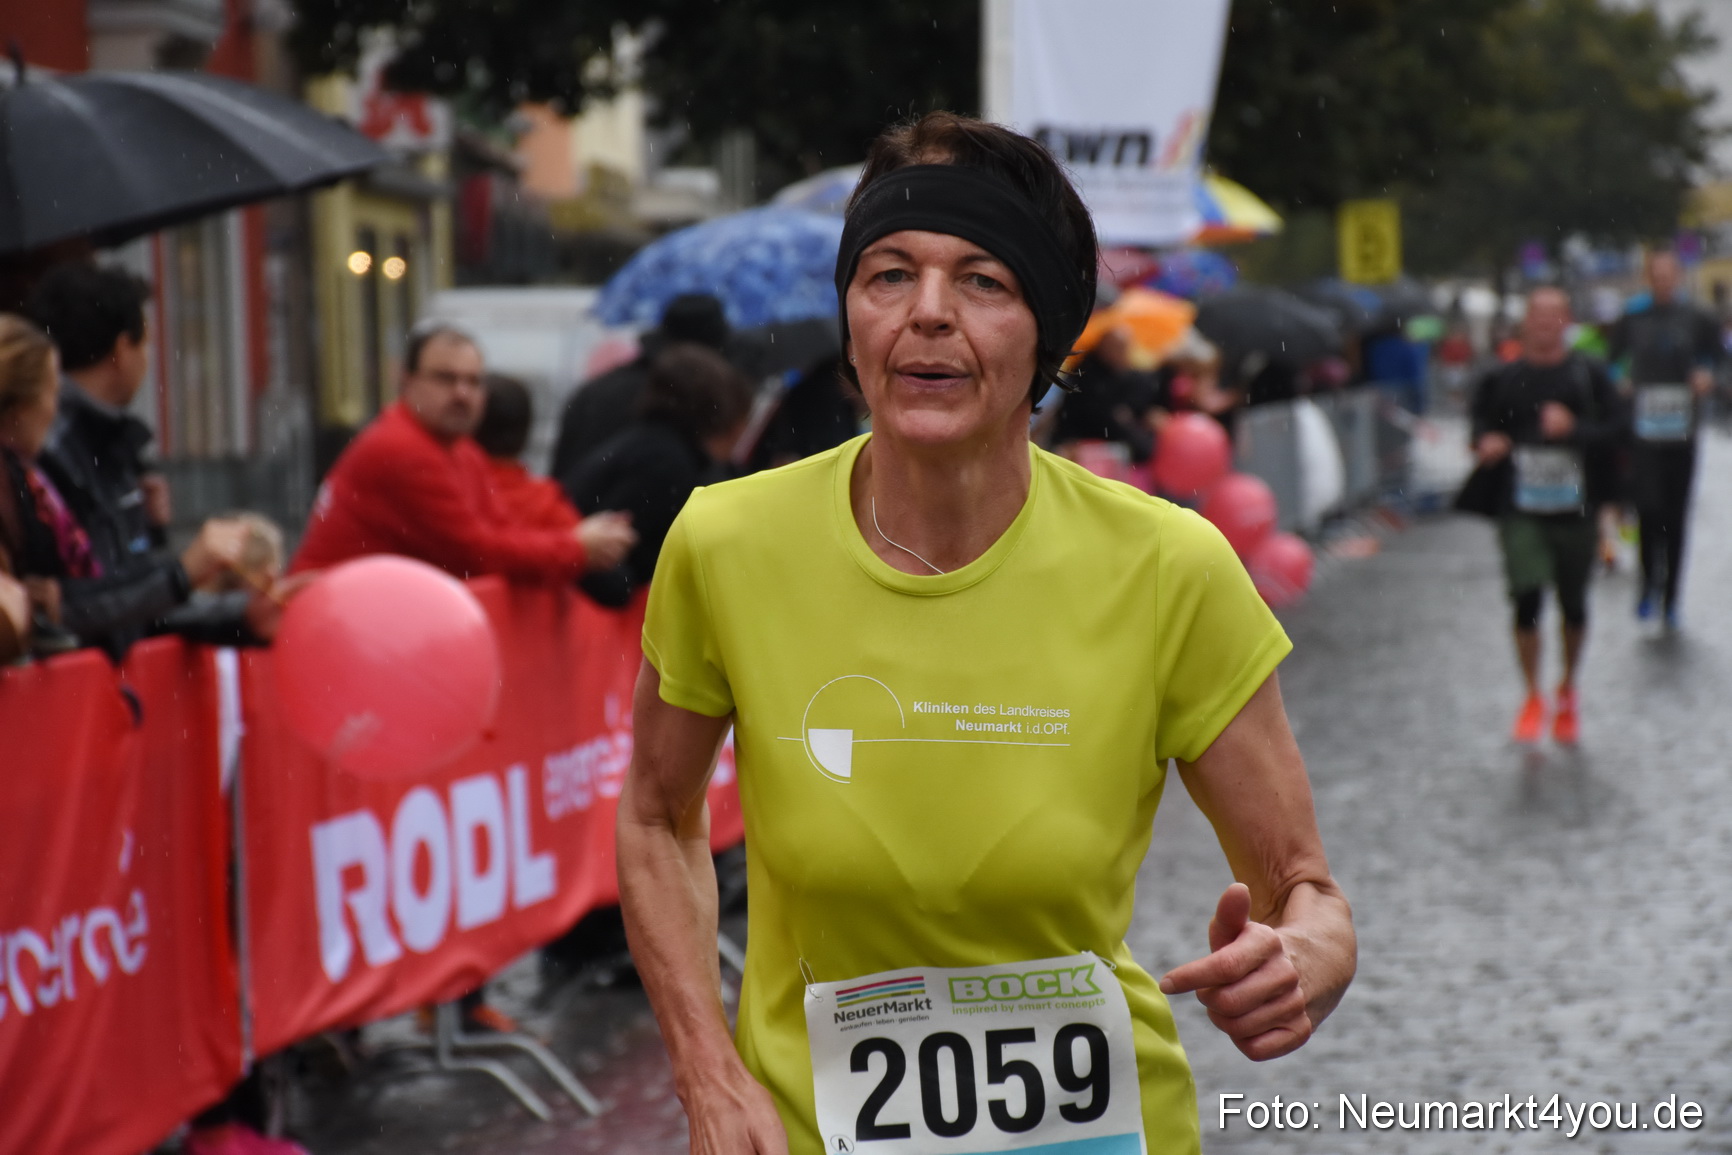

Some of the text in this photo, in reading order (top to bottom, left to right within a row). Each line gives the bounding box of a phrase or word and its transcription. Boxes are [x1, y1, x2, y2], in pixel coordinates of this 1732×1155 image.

[913, 701, 1070, 718] Kliniken des Landkreises
[956, 719, 1070, 735] Neumarkt i.d.OPf.
[948, 963, 1102, 1003] BOCK
[834, 998, 932, 1024] NeuerMarkt
[952, 998, 1105, 1016] inspired by smart concepts
[840, 1014, 930, 1032] einkaufen leben genießen
[850, 1022, 1110, 1141] 2059
